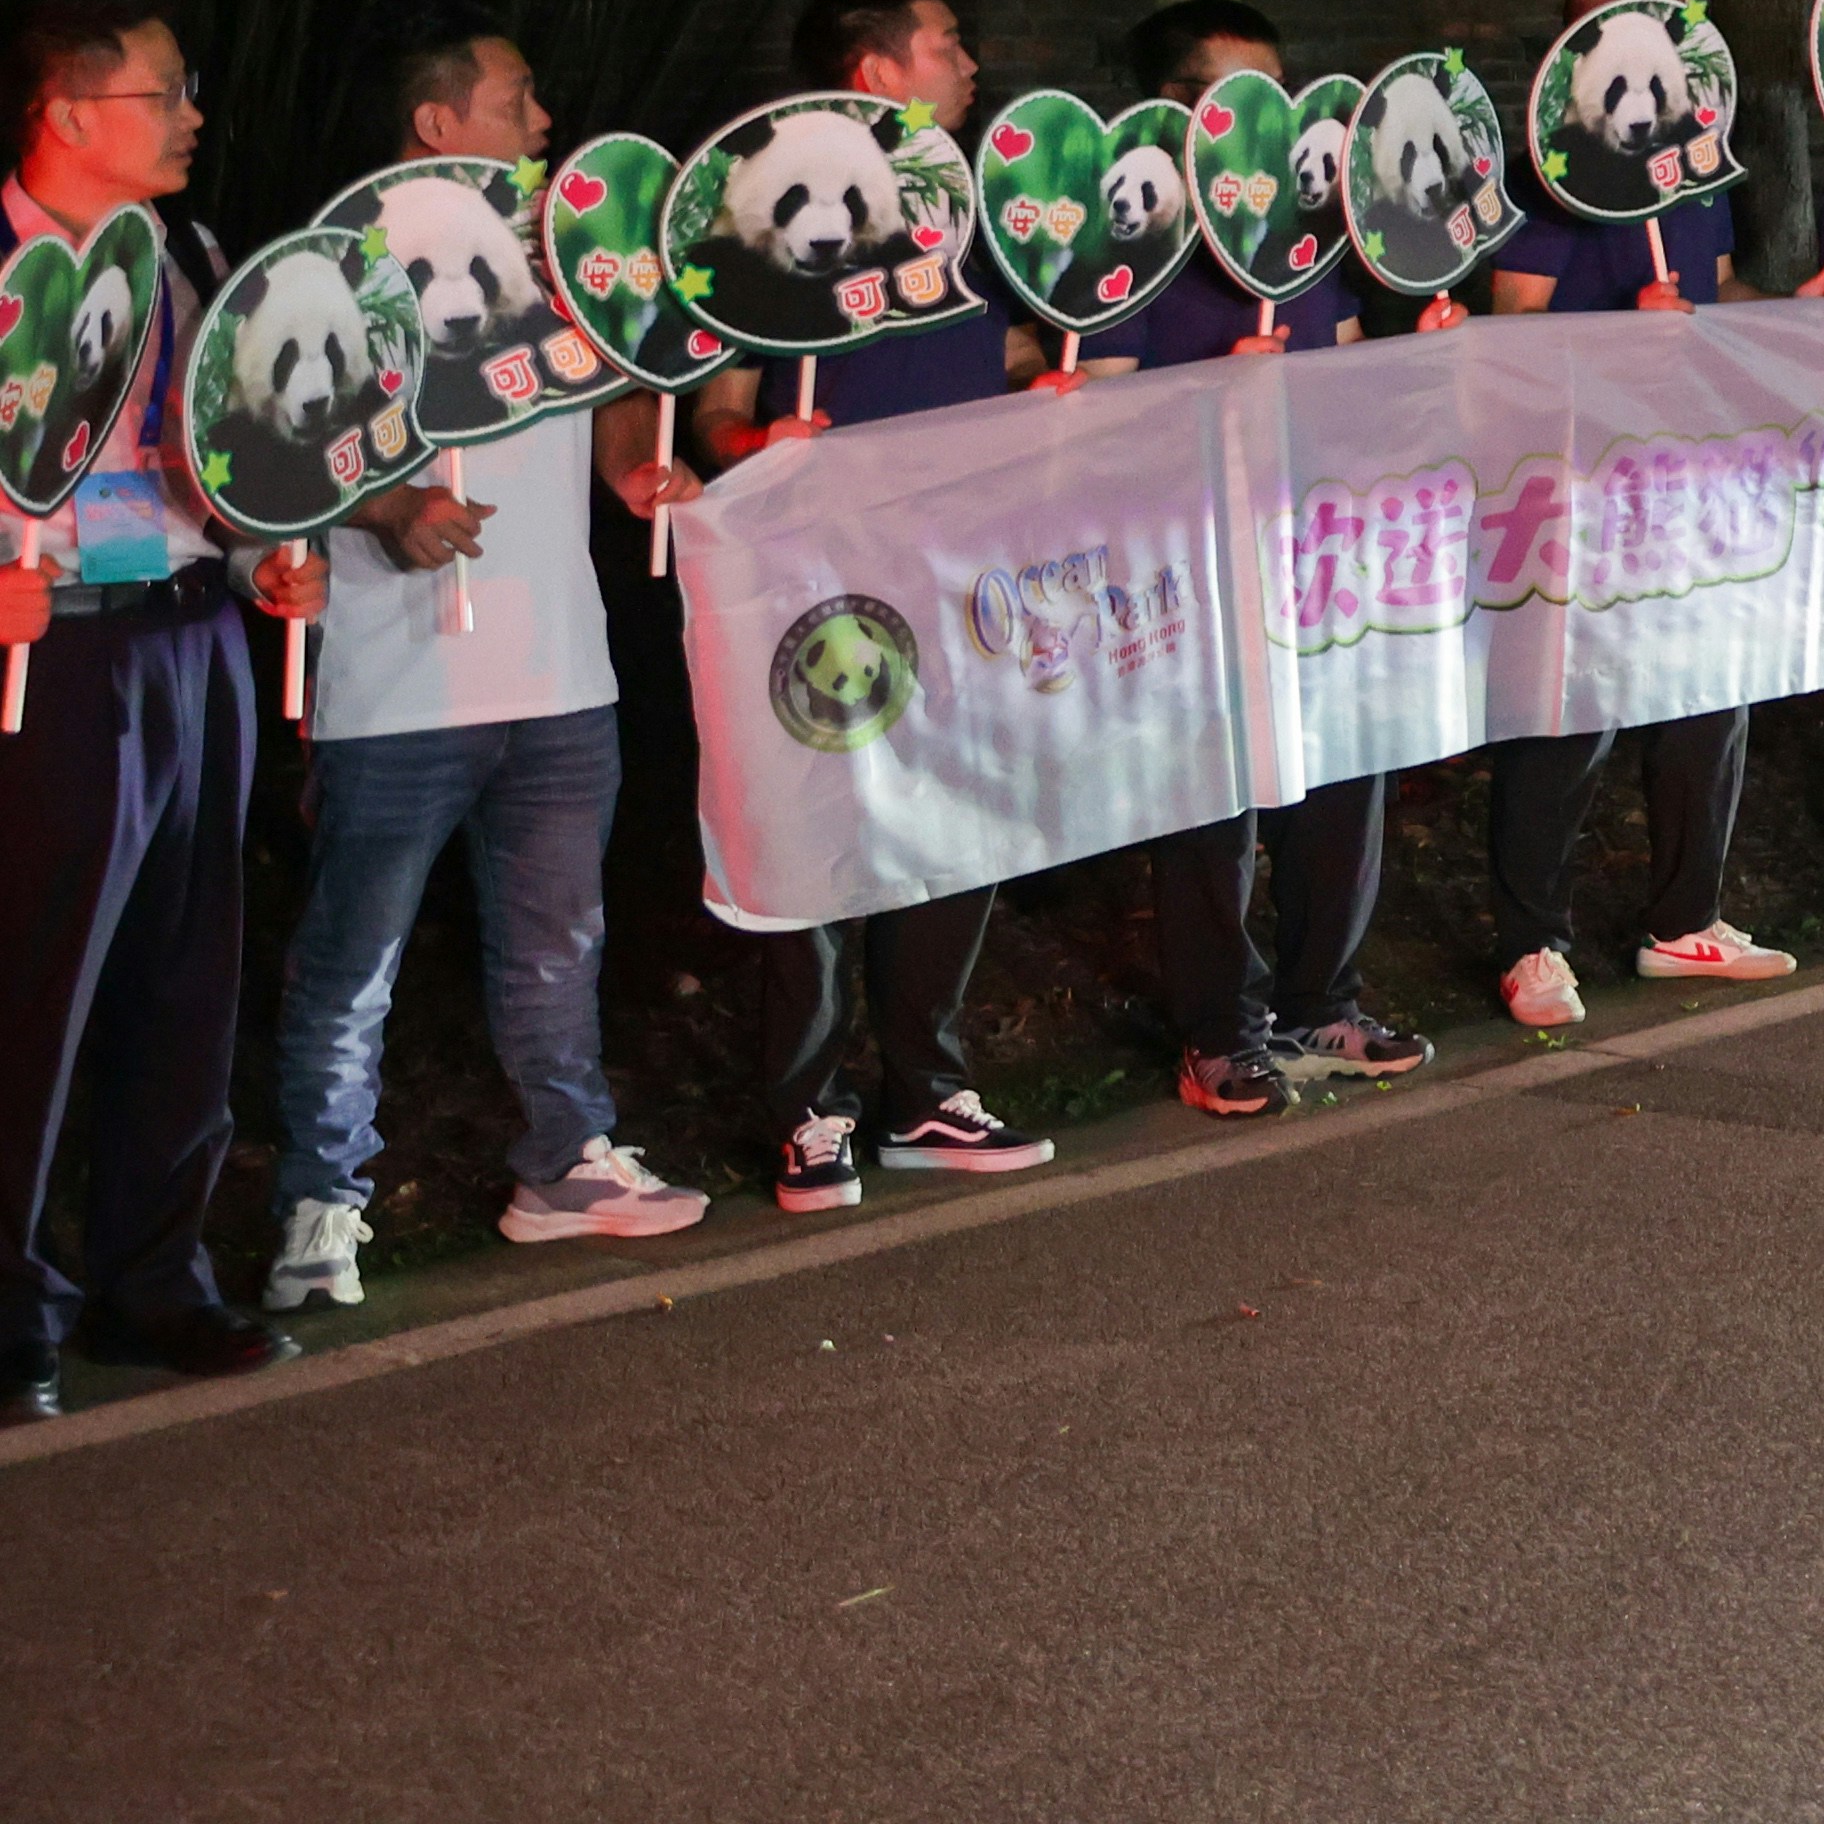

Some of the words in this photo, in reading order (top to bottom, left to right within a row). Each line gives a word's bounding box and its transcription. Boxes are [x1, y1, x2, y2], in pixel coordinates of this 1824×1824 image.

[1650, 131, 1720, 188] 可可
[1004, 197, 1086, 243] 安安
[1211, 173, 1276, 215] 安安
[1449, 182, 1502, 248] 可可
[581, 250, 663, 297] 安安
[836, 255, 946, 319] 可可
[485, 331, 598, 401] 可可
[328, 403, 405, 484] 可可
[966, 544, 1109, 661] Ocean
[1109, 638, 1146, 665] Hong
[1149, 619, 1185, 645] Kong
